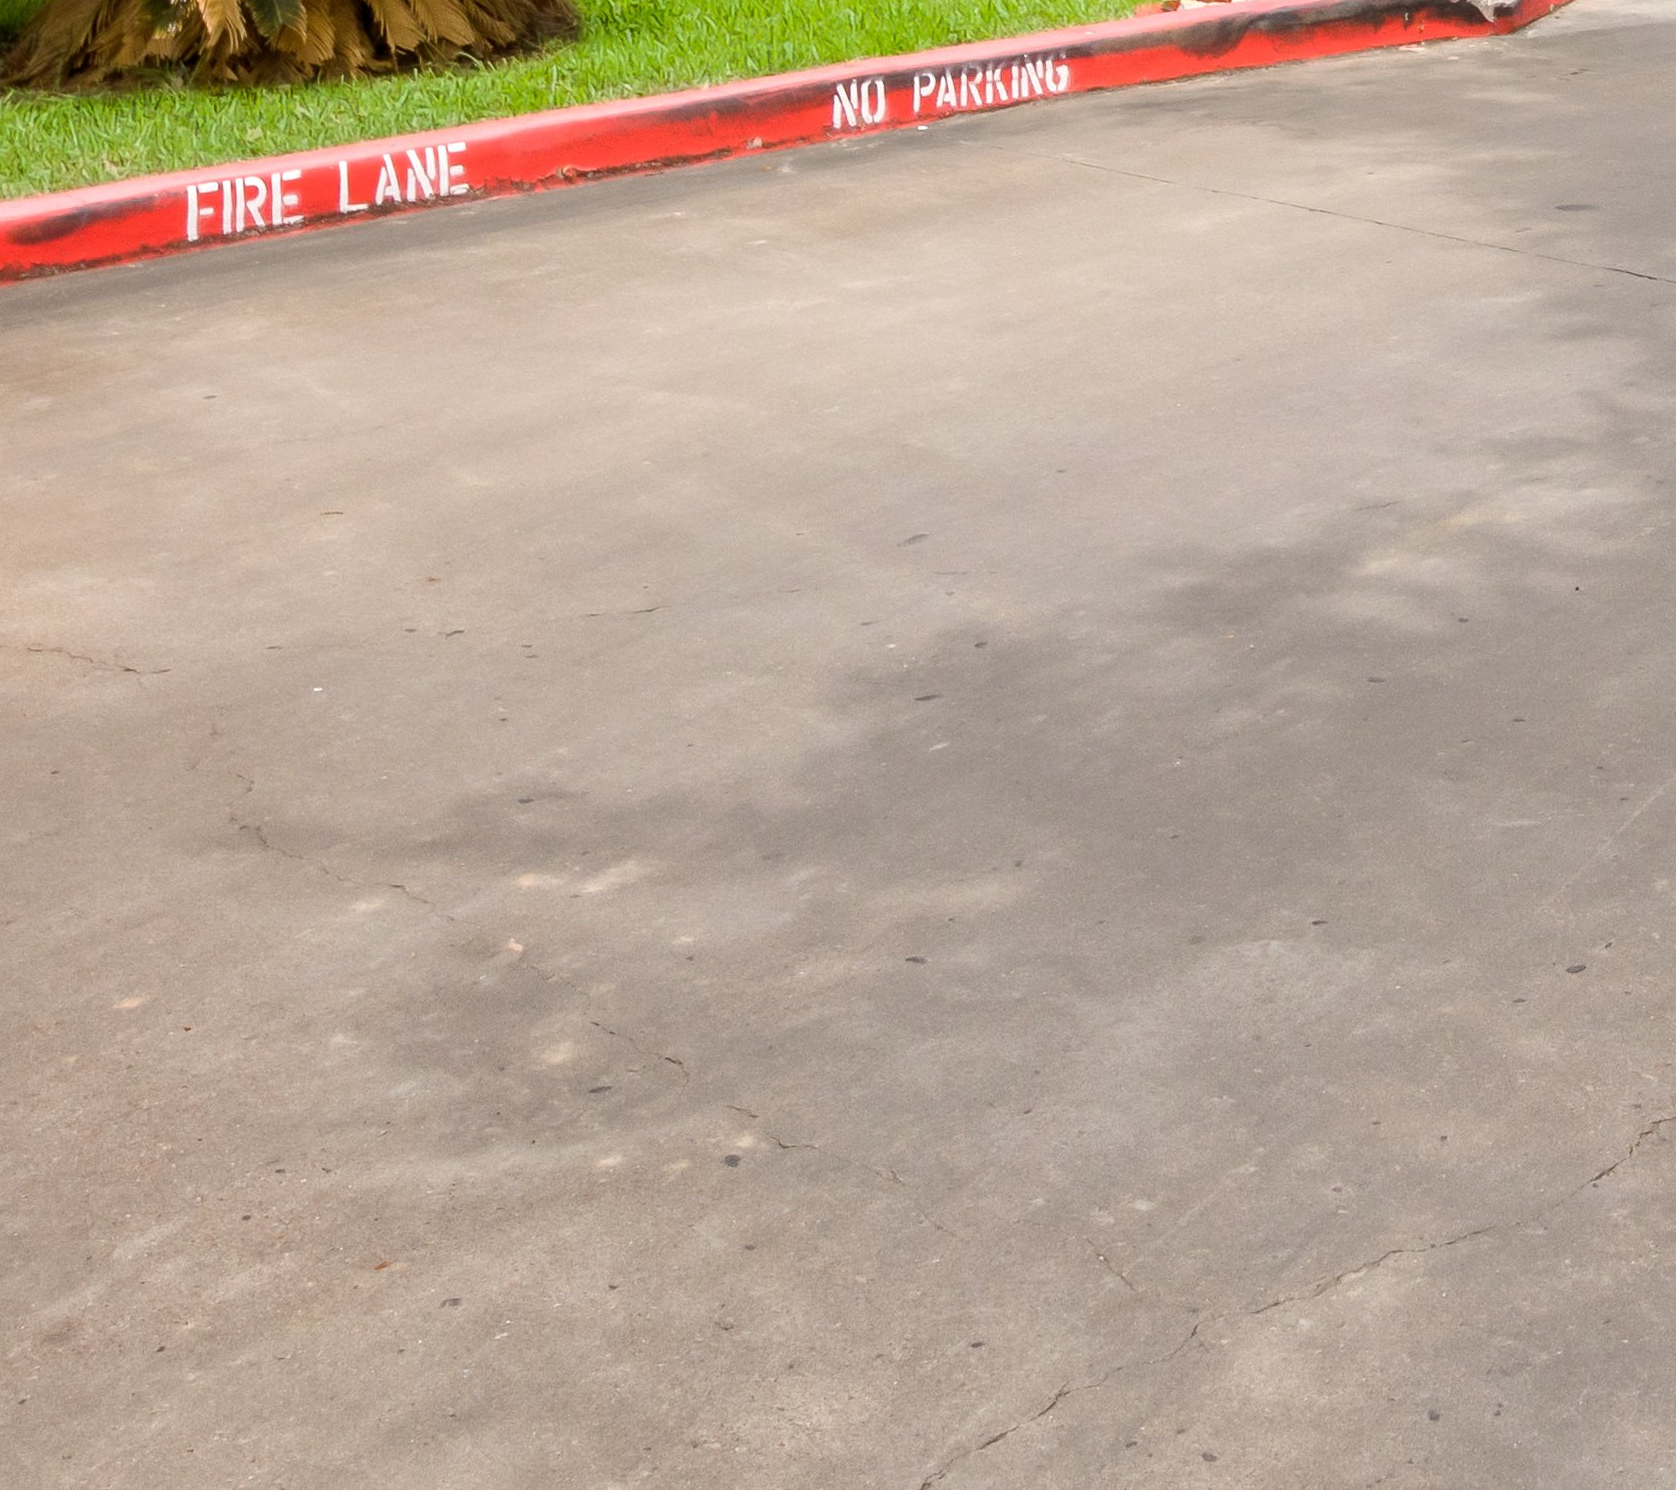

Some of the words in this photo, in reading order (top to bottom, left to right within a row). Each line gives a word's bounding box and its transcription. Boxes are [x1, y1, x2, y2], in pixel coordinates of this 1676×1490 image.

[832, 77, 887, 130] NO
[912, 52, 1071, 114] PARKING
[186, 169, 305, 242] FIRE
[338, 141, 471, 214] LANE
